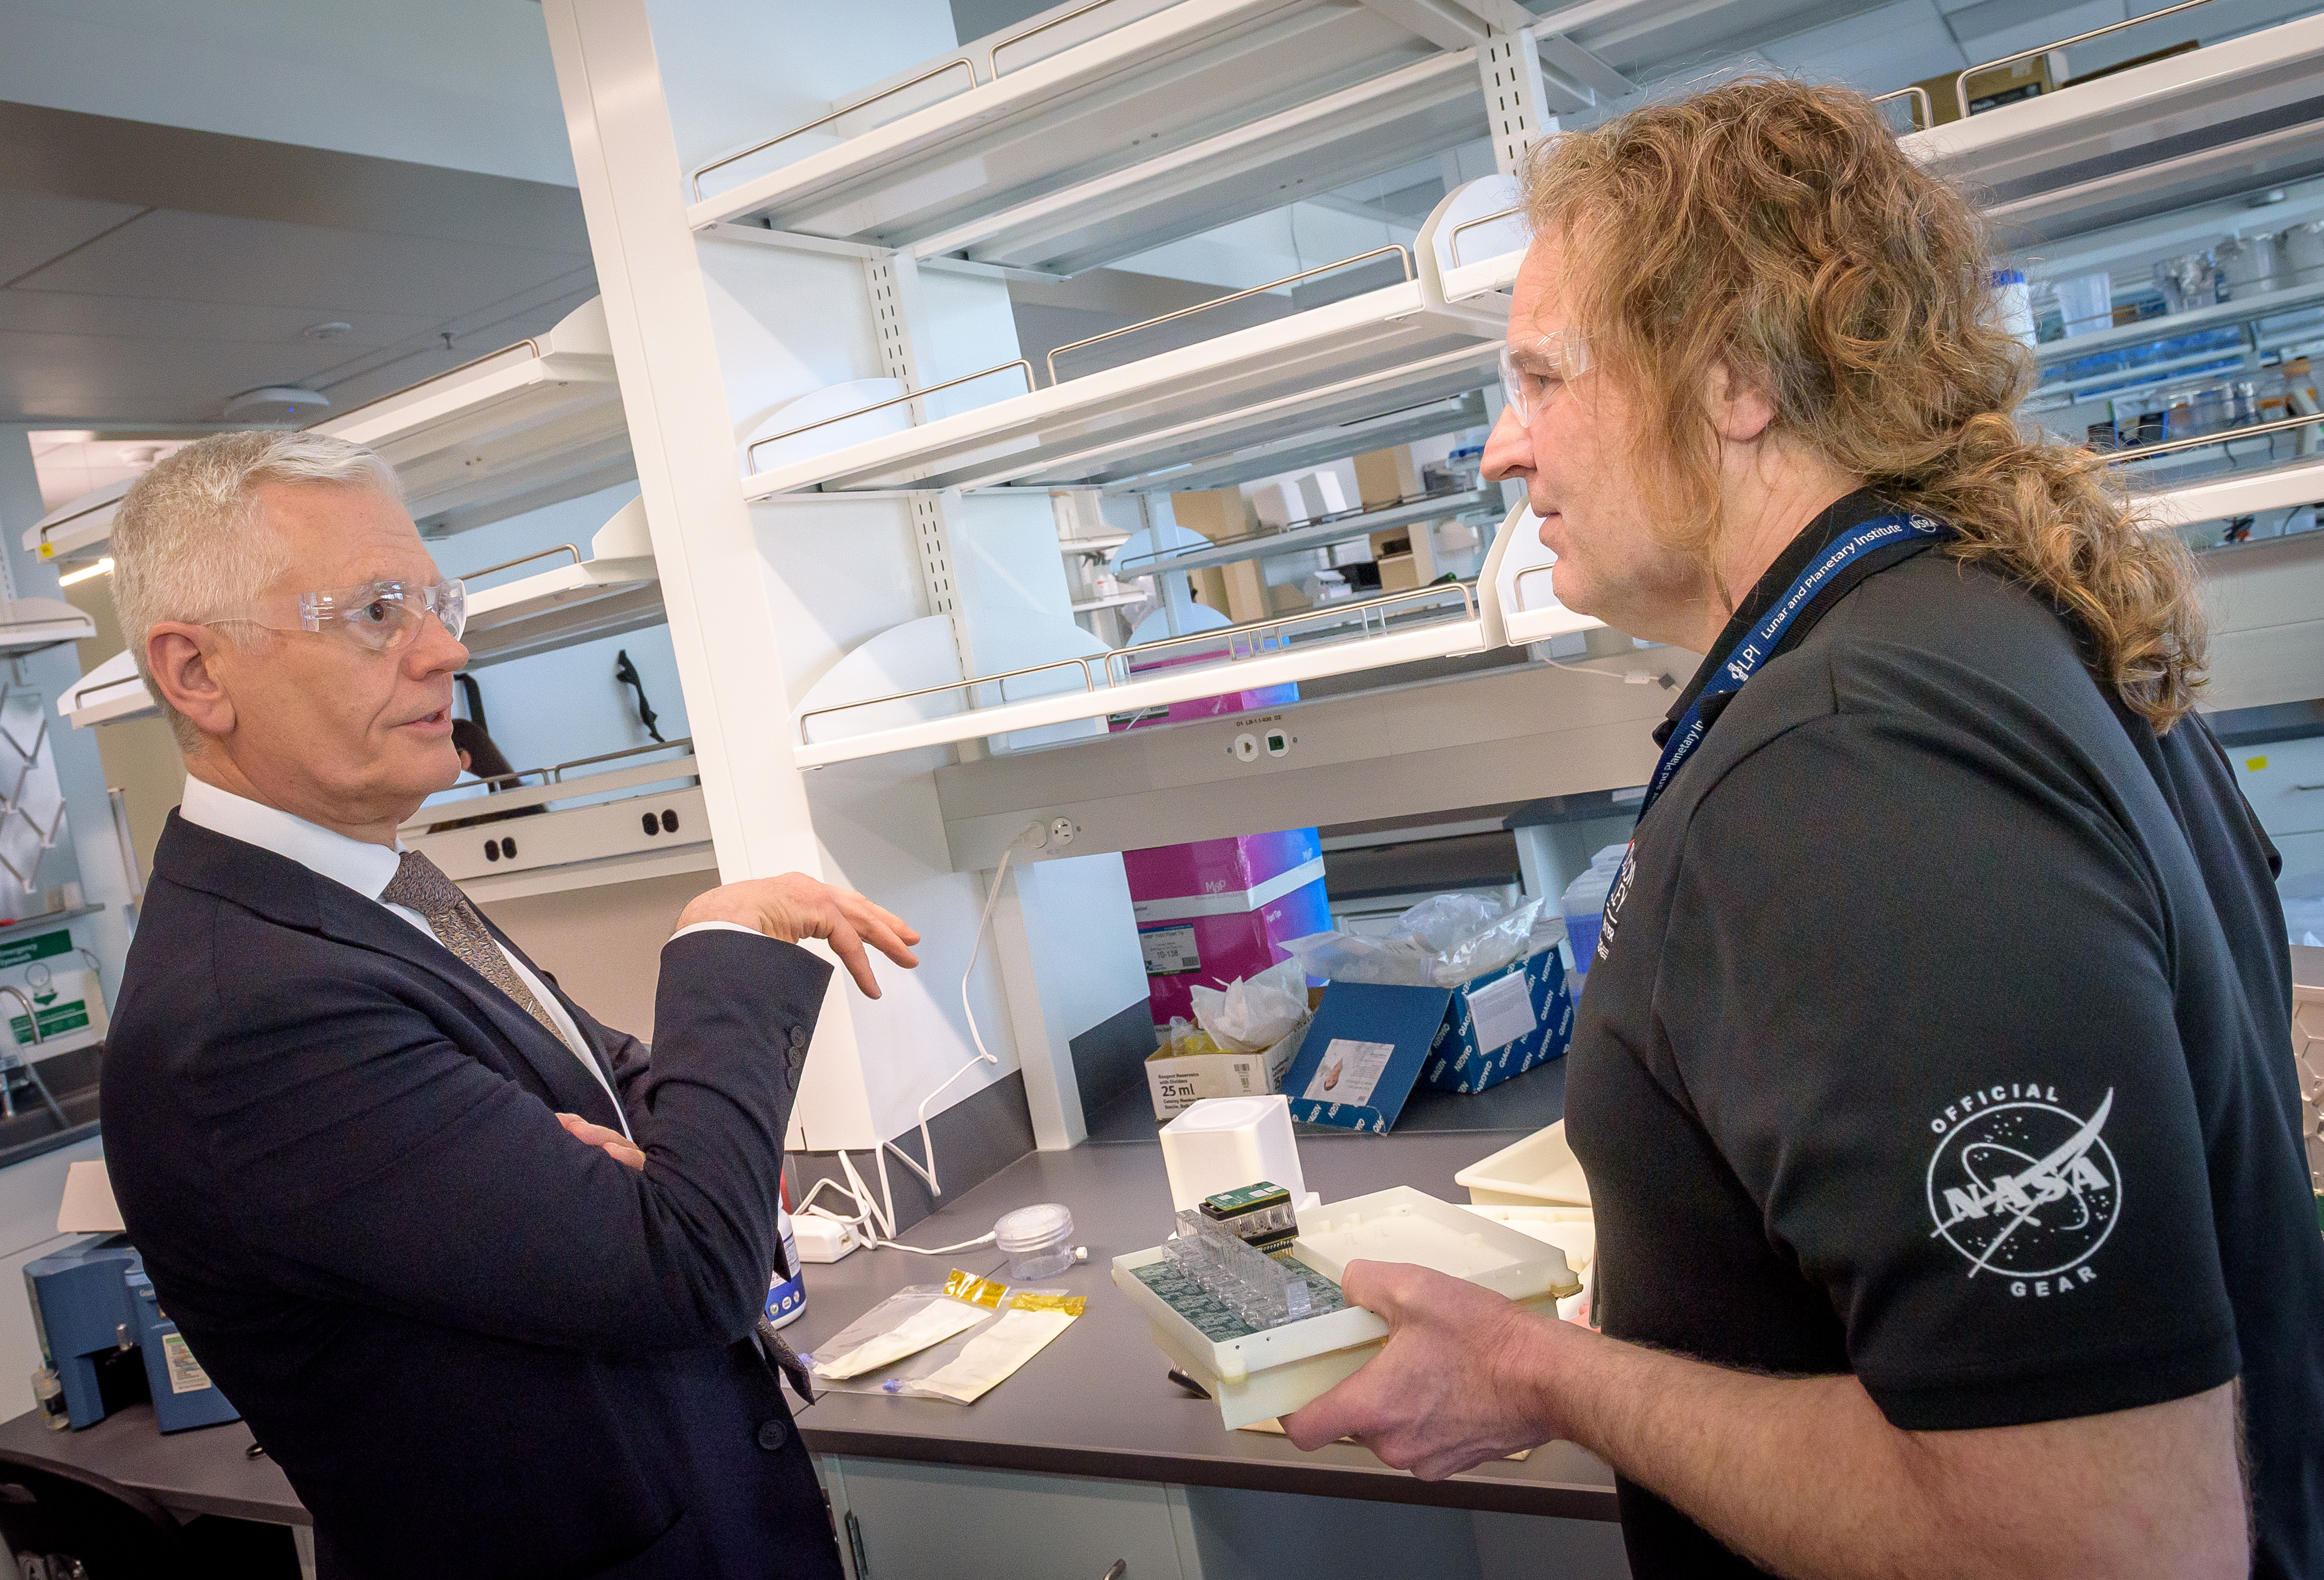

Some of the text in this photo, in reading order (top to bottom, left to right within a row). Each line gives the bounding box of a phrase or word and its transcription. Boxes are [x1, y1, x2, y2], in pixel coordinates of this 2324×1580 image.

[1761, 523, 1902, 639] Lunar and Planetary Institute
[1737, 645, 1761, 671] LPI
[1657, 773, 1669, 790] and
[1664, 730, 1699, 770] Planetary
[1542, 952, 1554, 982] QIAGEN
[1541, 990, 1554, 1021] QIAGEN
[1559, 1005, 1571, 1036] QIAGEN
[1433, 1023, 1450, 1049] QIAGEN
[1538, 1029, 1552, 1059] QIAGEN
[1430, 1058, 1447, 1083] QIAGEN
[1454, 1045, 1472, 1072] QIAGEN
[1161, 1083, 1195, 1097] 25 ml
[1476, 1060, 1493, 1093] QIAGEN
[1931, 1083, 2058, 1133] OFFICIAL
[1943, 1156, 2110, 1223] NASA
[2010, 1266, 2097, 1297] GEAR
